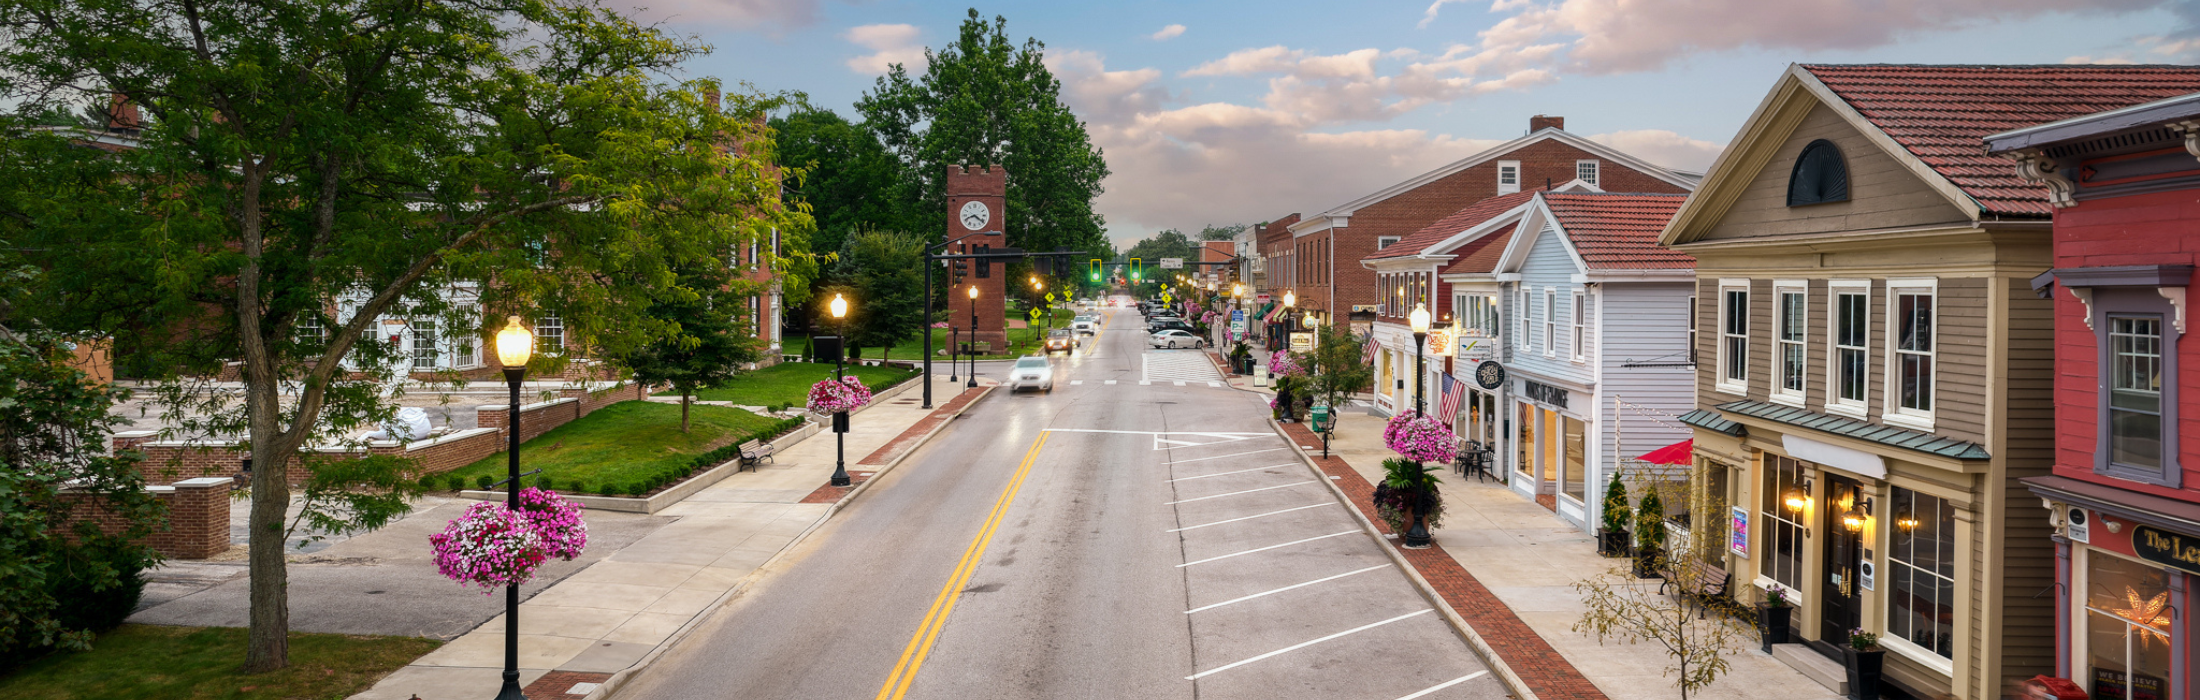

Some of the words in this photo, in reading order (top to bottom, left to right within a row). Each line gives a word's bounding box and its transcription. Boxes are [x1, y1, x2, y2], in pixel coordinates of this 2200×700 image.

[2144, 530, 2170, 552] The
[2099, 671, 2113, 679] WE
[2117, 674, 2158, 686] BEIEVE
